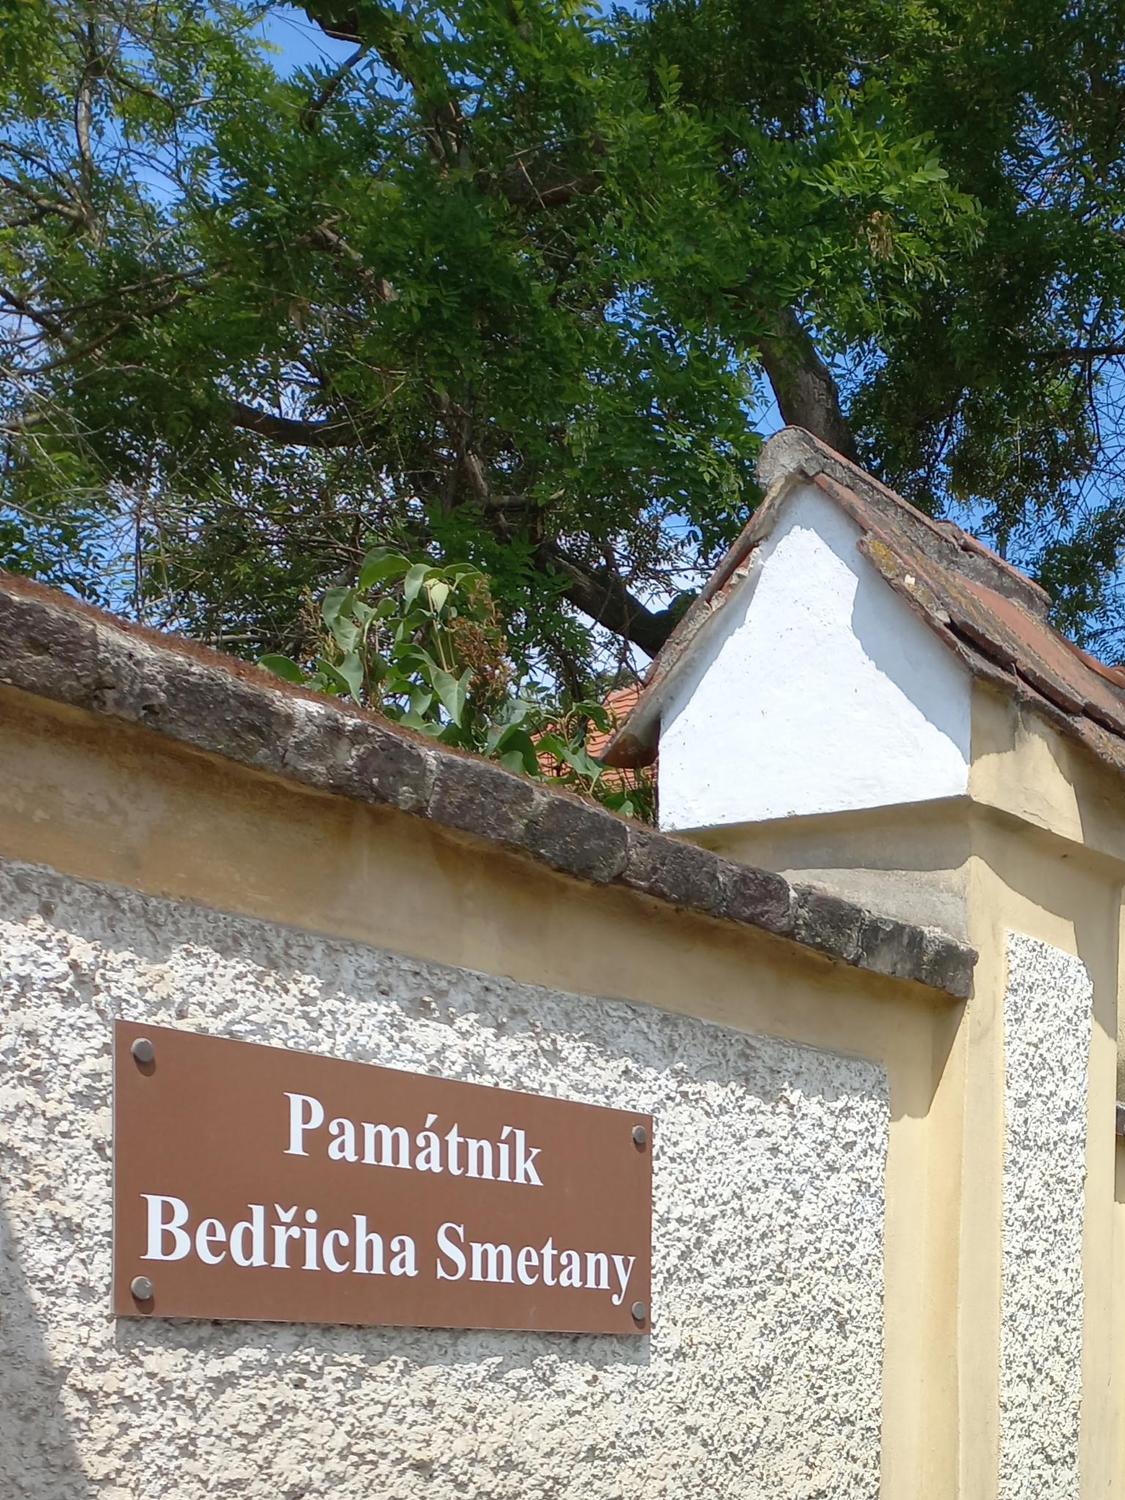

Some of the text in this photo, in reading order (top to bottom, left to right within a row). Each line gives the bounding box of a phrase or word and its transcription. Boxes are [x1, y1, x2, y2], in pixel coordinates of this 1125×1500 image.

[283, 1092, 544, 1186] Památník
[139, 1193, 637, 1306] Bedřicha Smetany
